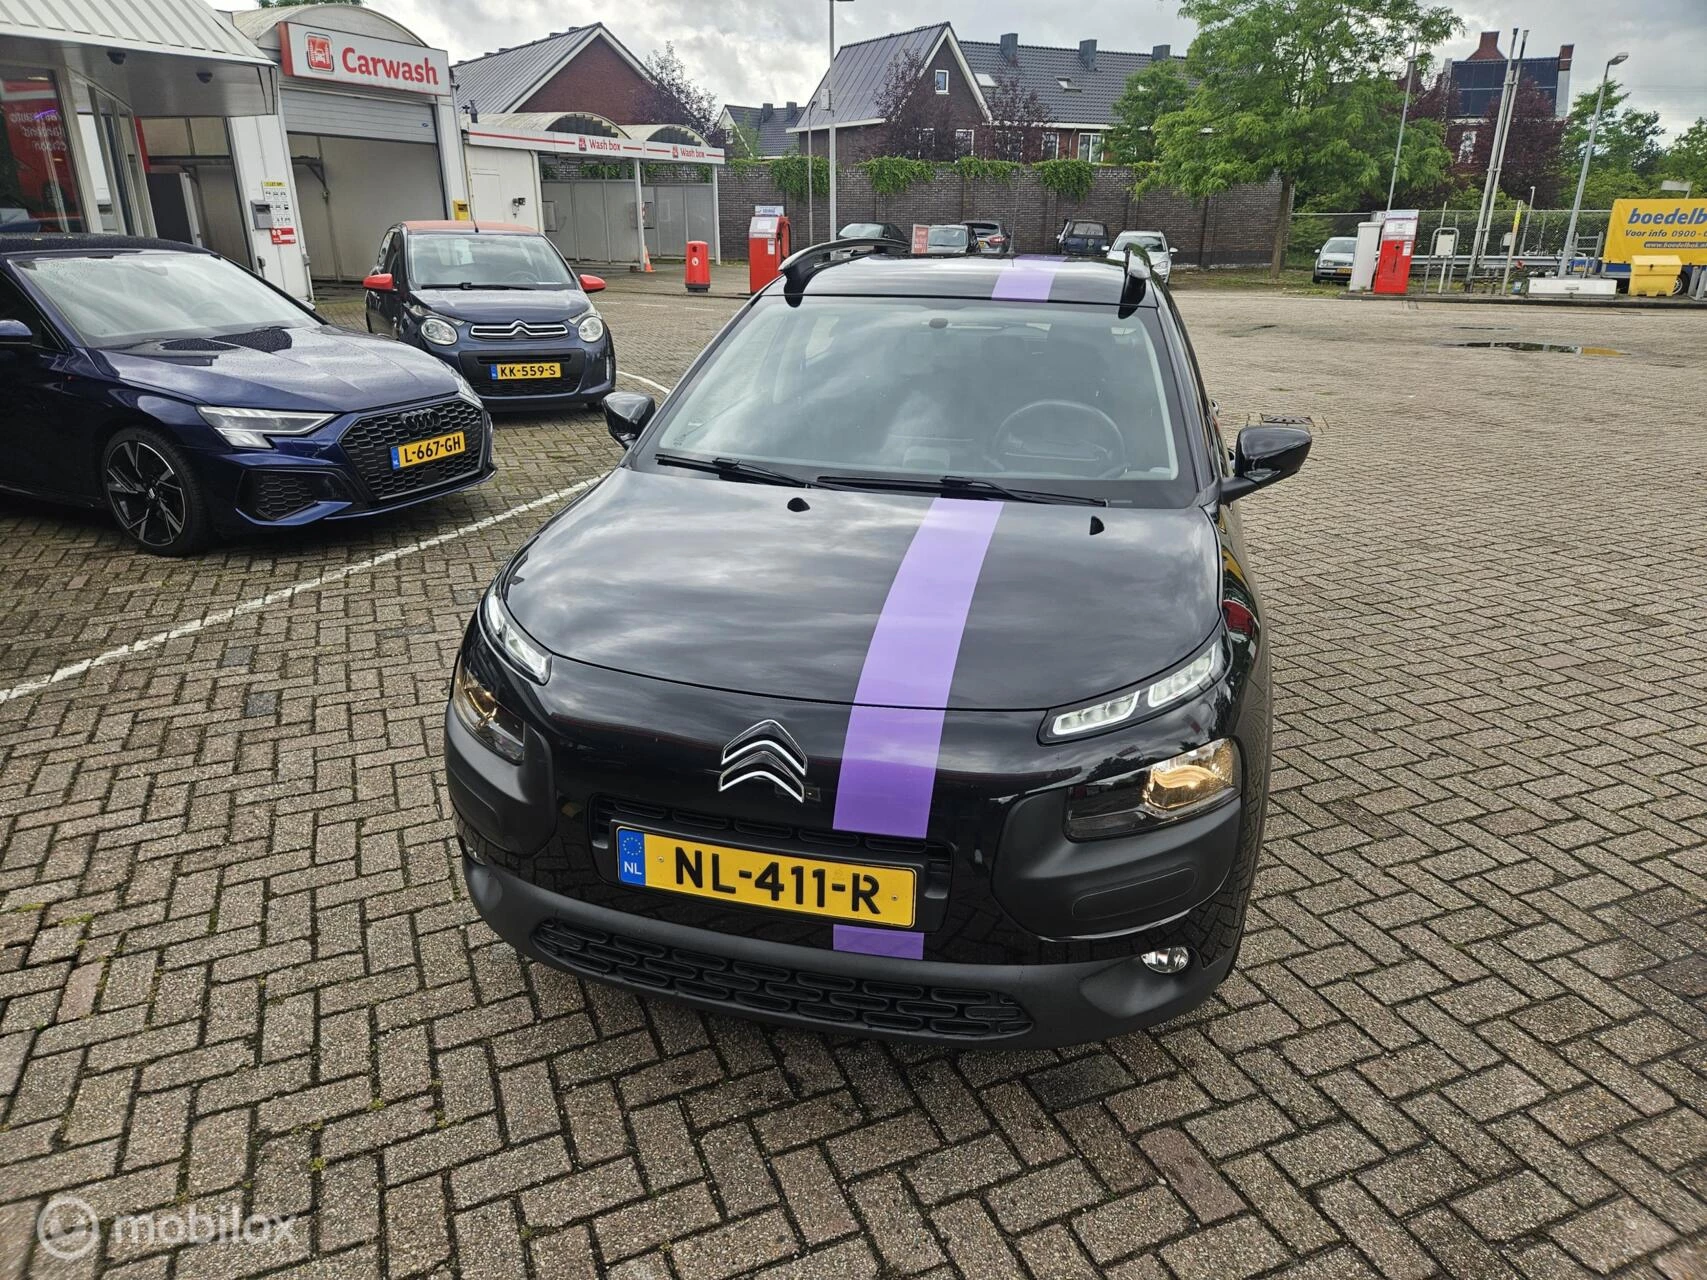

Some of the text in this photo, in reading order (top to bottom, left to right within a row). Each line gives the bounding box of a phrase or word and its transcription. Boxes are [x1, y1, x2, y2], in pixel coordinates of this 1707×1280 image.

[341, 47, 439, 86] Carwash
[589, 139, 621, 151] Wash box
[680, 147, 705, 158] Wash box
[1625, 229, 1646, 237] Voor
[1648, 229, 1667, 237] info
[500, 365, 556, 377] KK-559-S
[404, 435, 461, 463] L-667-GH
[623, 846, 881, 914] NL NL-411-R
